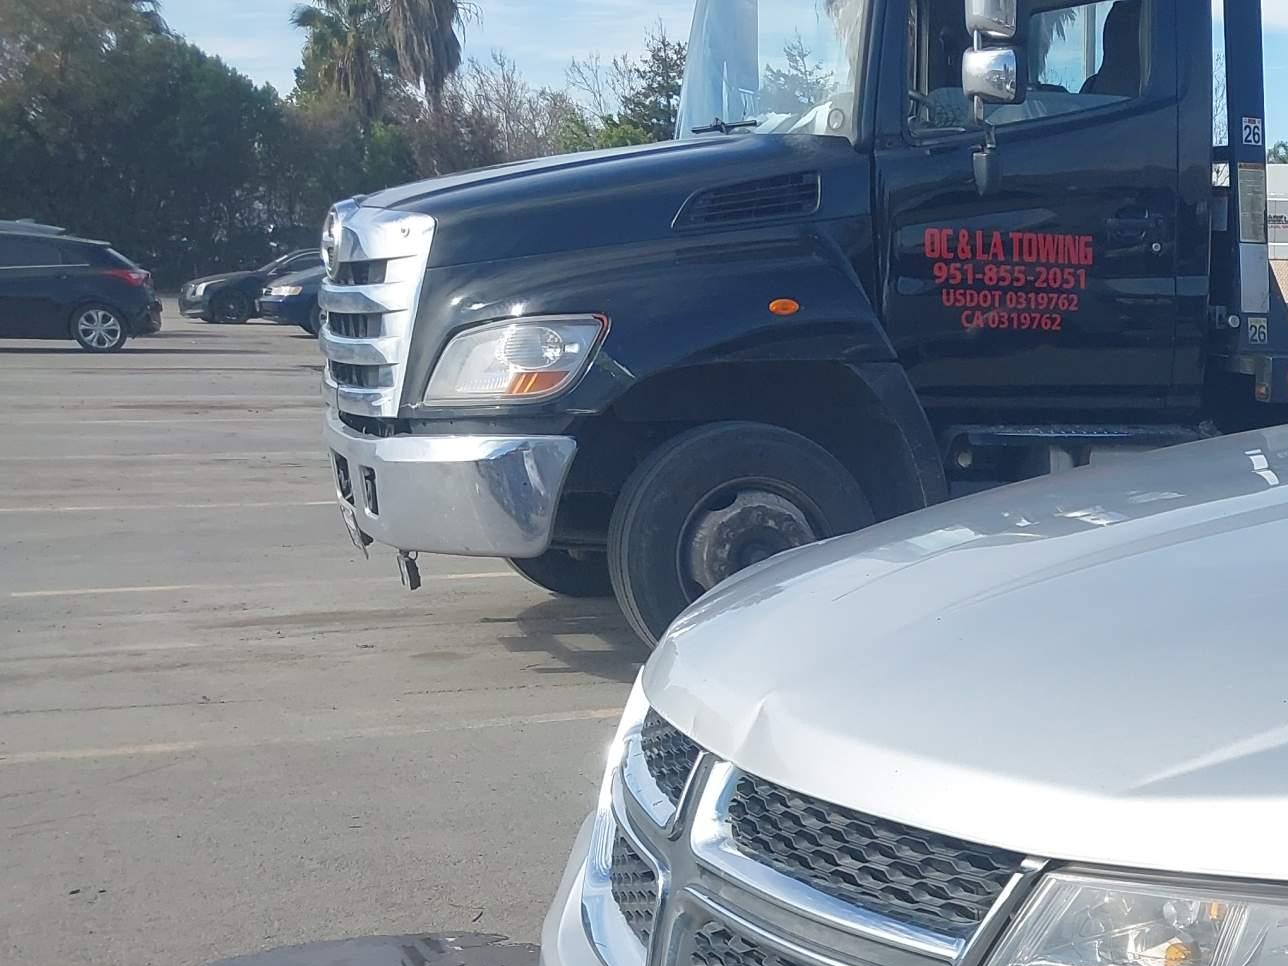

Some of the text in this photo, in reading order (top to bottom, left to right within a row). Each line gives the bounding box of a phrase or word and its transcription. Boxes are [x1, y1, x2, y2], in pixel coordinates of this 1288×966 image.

[1244, 124, 1260, 144] 26
[925, 228, 1093, 264] OC & LA TOWING
[933, 263, 1086, 289] 951-855-2051
[942, 289, 1078, 311] USDOT 0319762
[961, 311, 1061, 330] CA 0319762
[1249, 325, 1265, 342] 26
